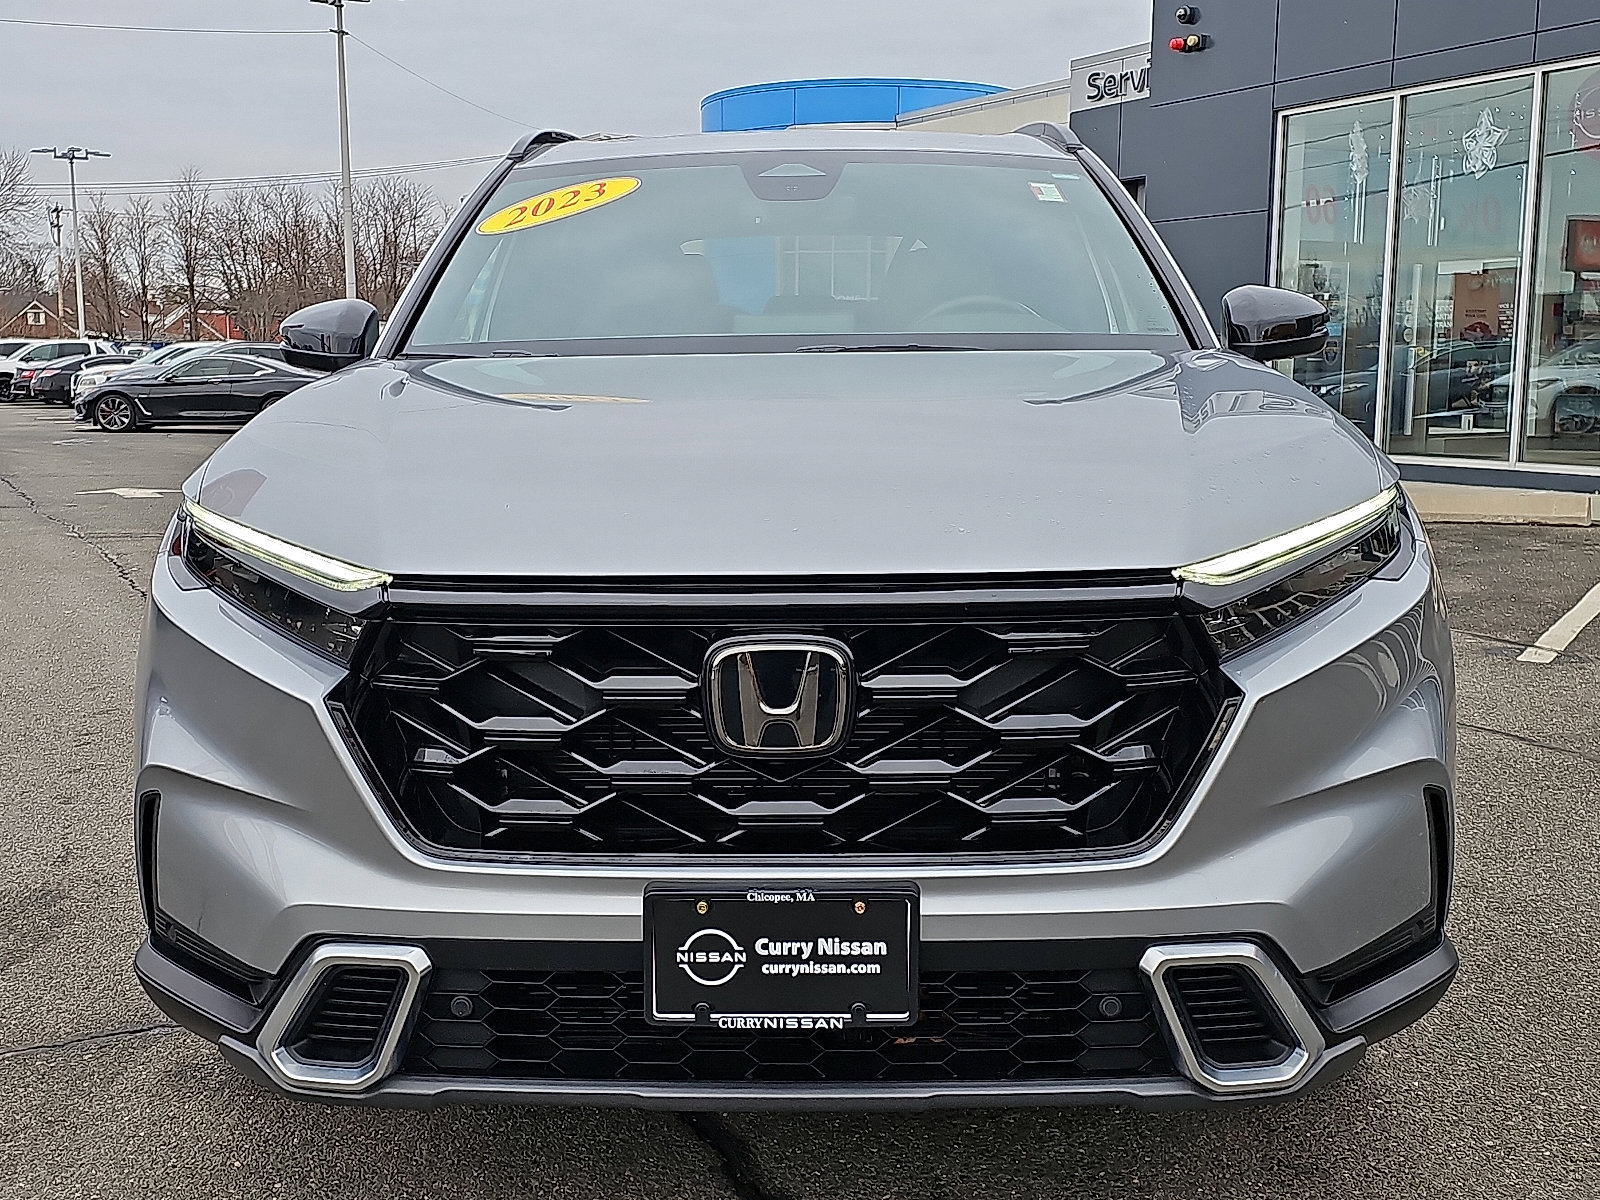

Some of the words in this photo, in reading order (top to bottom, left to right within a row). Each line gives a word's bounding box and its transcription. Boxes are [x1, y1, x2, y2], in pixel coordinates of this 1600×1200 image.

[504, 181, 607, 228] 2023
[746, 891, 794, 904] Chicopee,
[795, 892, 816, 902] MA
[676, 951, 747, 963] NISSAN
[755, 937, 813, 960] Curry
[817, 937, 888, 956] Nissan
[761, 960, 881, 977] currynissan.com
